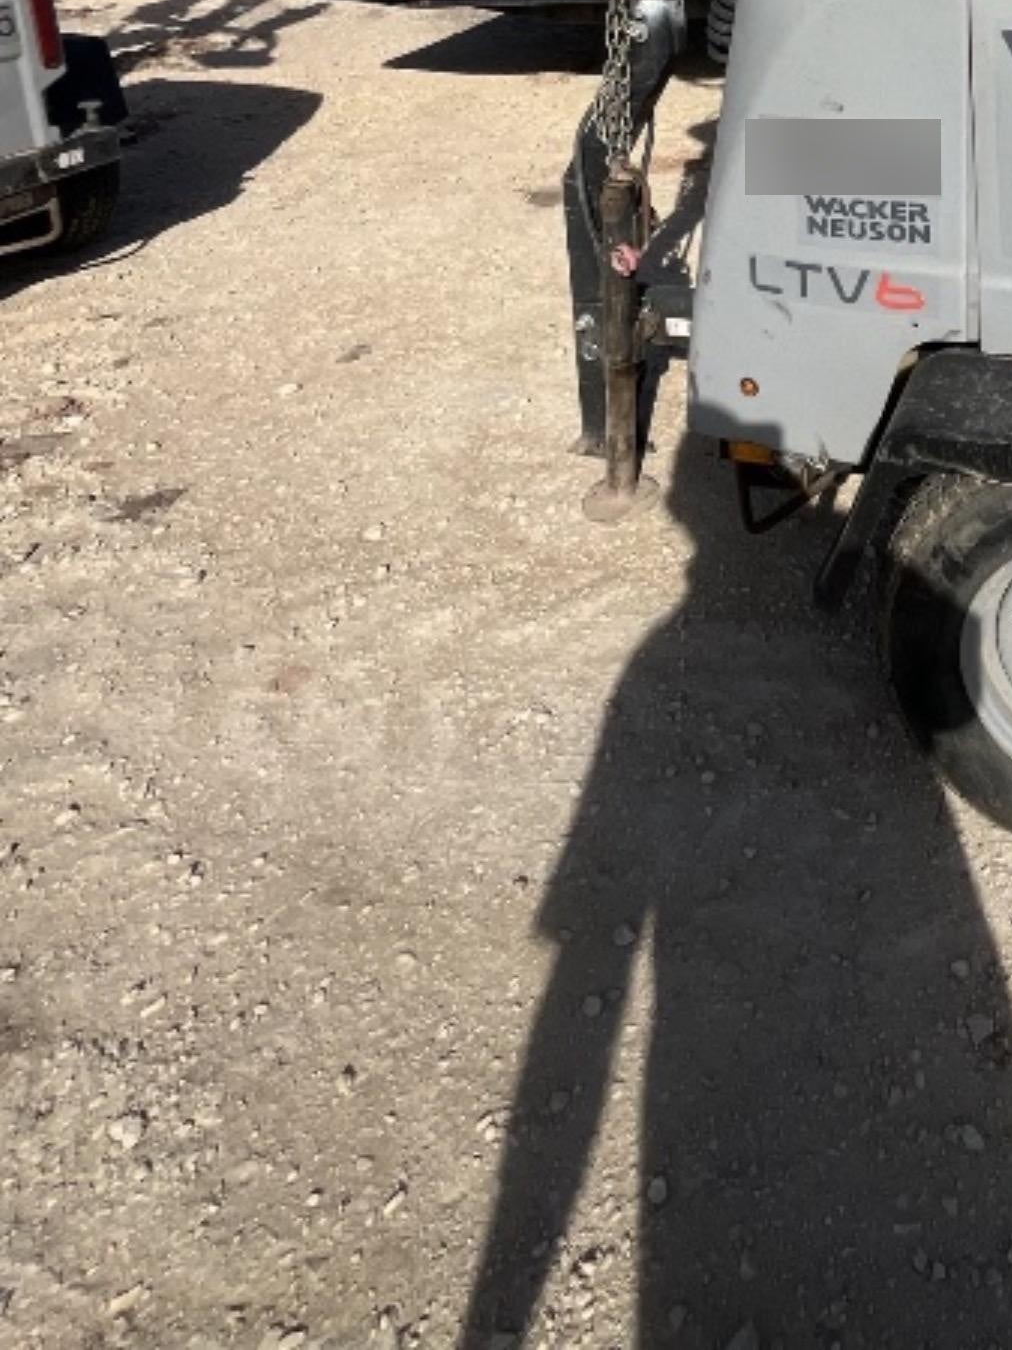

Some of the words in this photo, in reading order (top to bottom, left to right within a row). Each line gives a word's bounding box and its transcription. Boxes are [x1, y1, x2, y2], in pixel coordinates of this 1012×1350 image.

[804, 194, 931, 223] WACKER
[806, 215, 931, 244] NEUSON
[749, 256, 926, 311] LTV6
